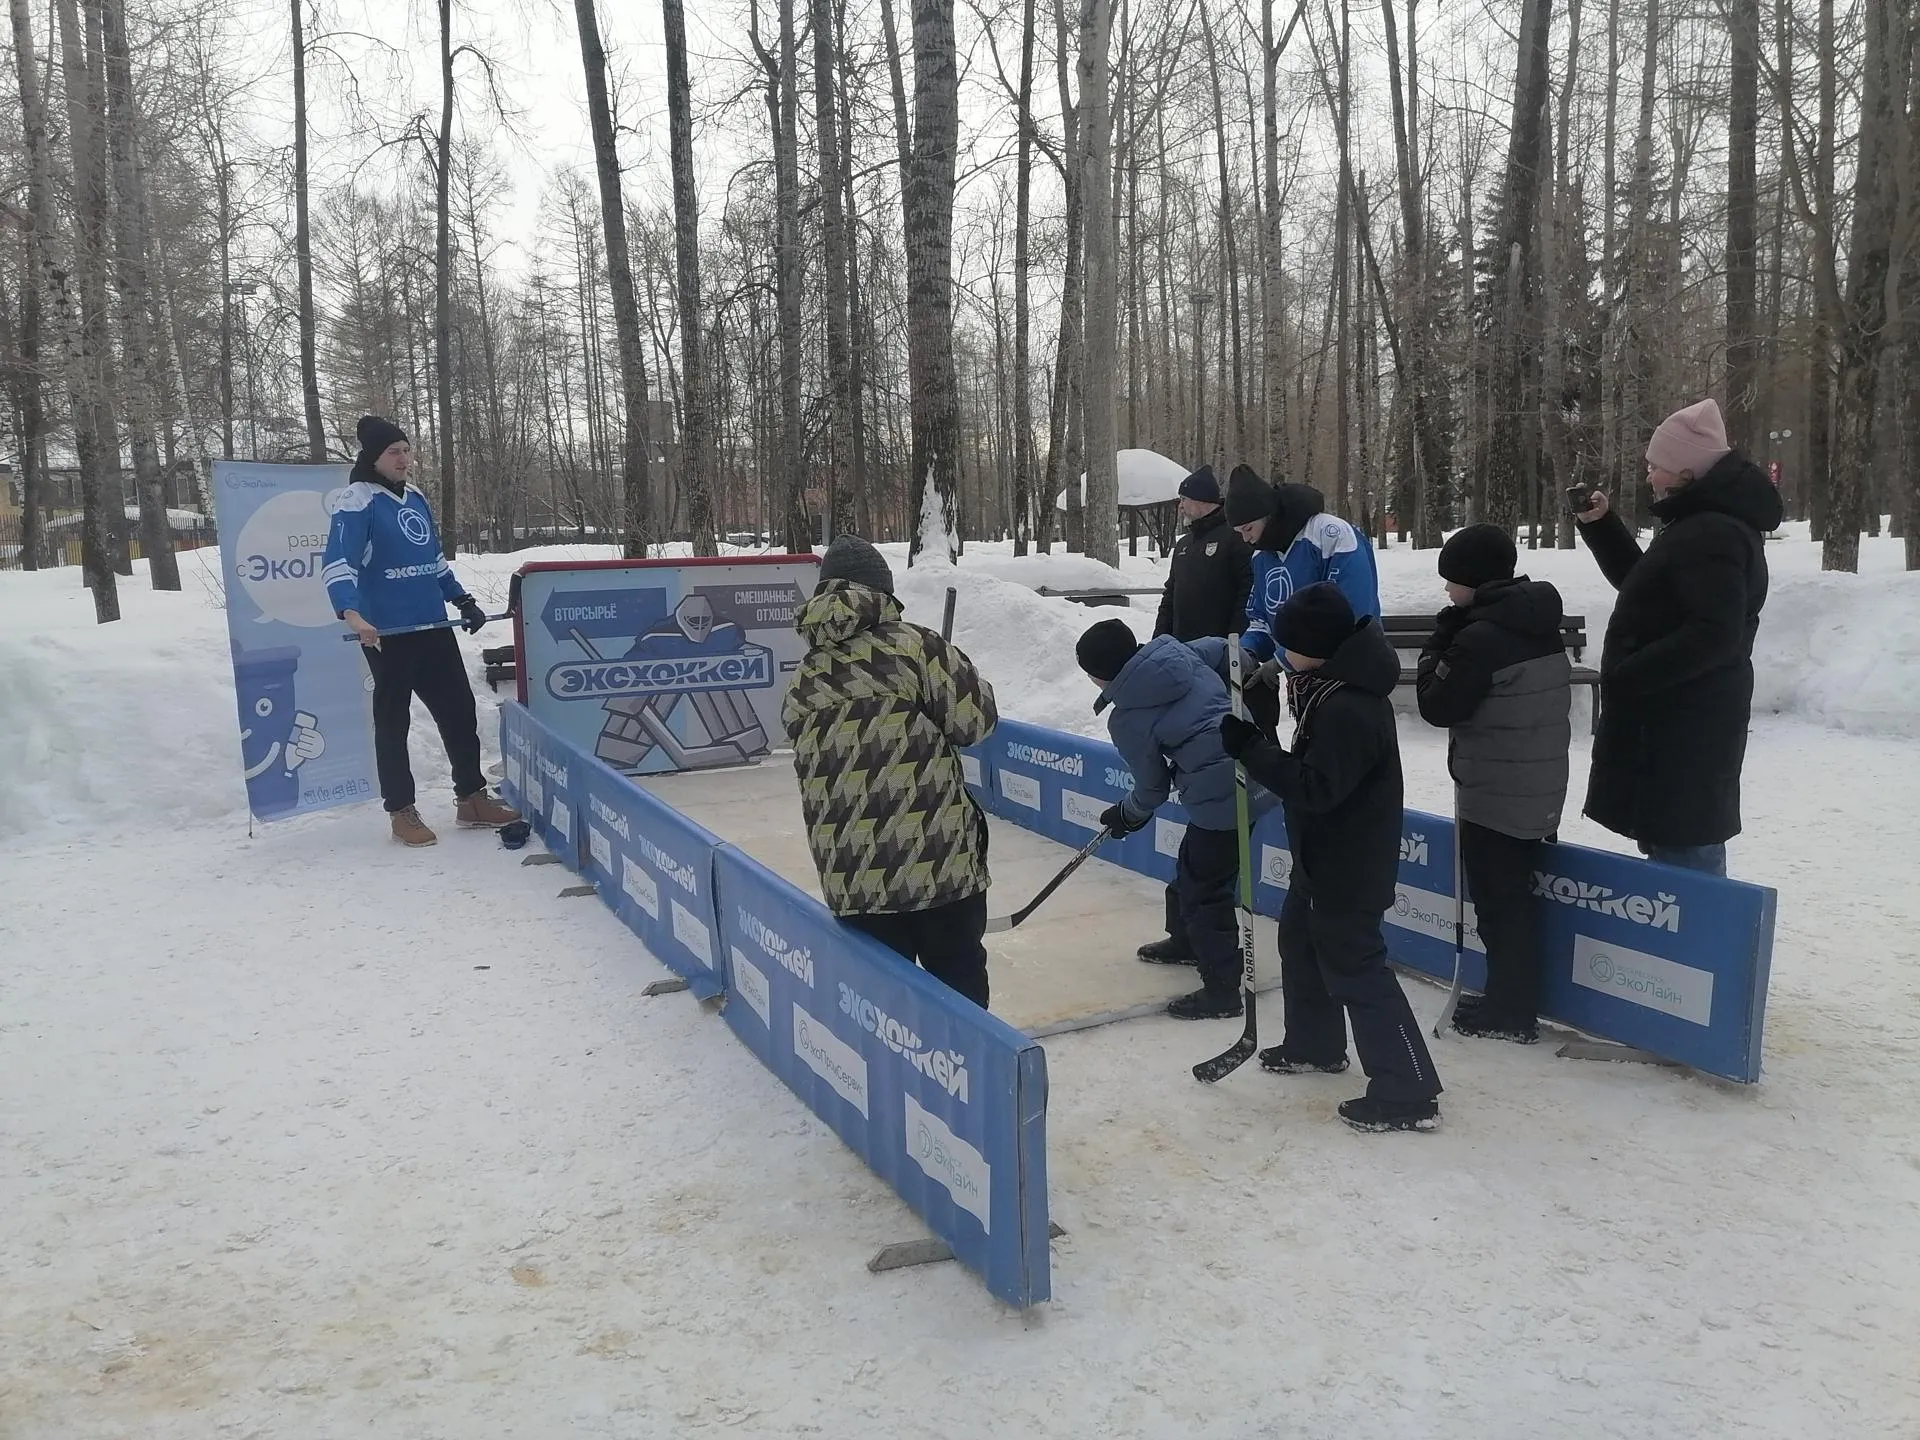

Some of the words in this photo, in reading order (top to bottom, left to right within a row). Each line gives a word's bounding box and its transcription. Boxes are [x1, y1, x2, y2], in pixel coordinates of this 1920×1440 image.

[554, 603, 617, 622] ВТОРСЫРЬЁ
[734, 589, 796, 605] СМЕШАННЫЕ
[1411, 907, 1481, 942] ЭкоПроСе
[1244, 925, 1254, 983] NORDWAY
[1615, 972, 1682, 1005] ЭкоЛайн
